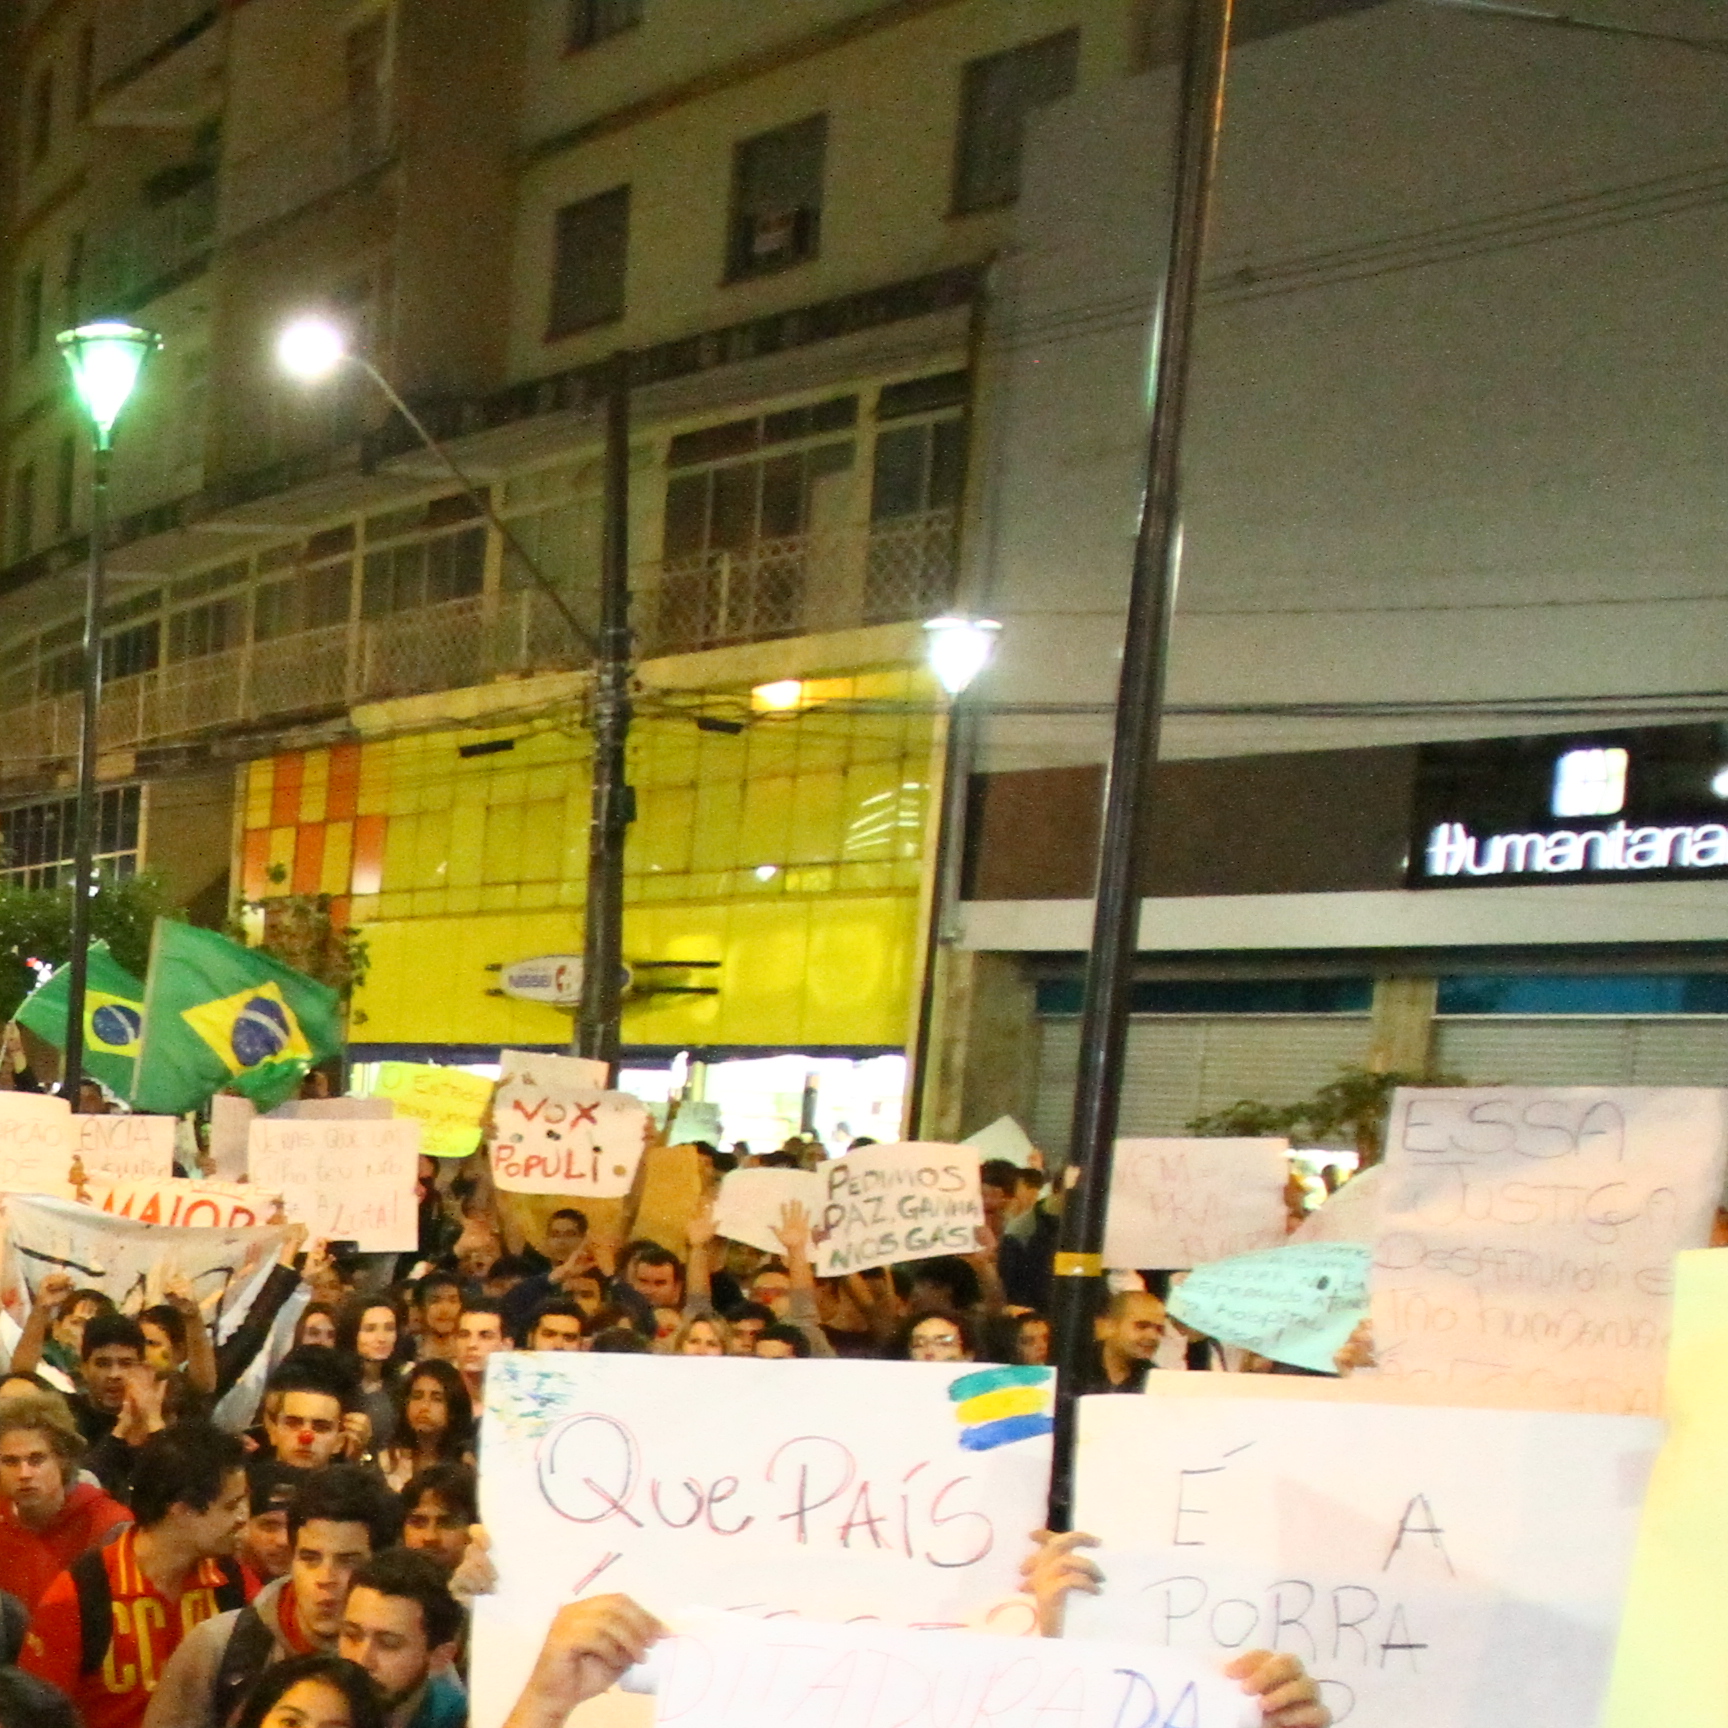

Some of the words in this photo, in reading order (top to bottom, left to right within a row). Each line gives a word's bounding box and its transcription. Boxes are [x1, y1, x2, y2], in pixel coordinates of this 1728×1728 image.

[512, 1097, 601, 1131] VOX
[1401, 1099, 1626, 1162] ESSA
[533, 1409, 757, 1538] Que
[764, 1433, 996, 1569] PAÍS
[1173, 1439, 1258, 1548] É
[1382, 1491, 1456, 1578] A
[1142, 1574, 1431, 1674] PORRA
